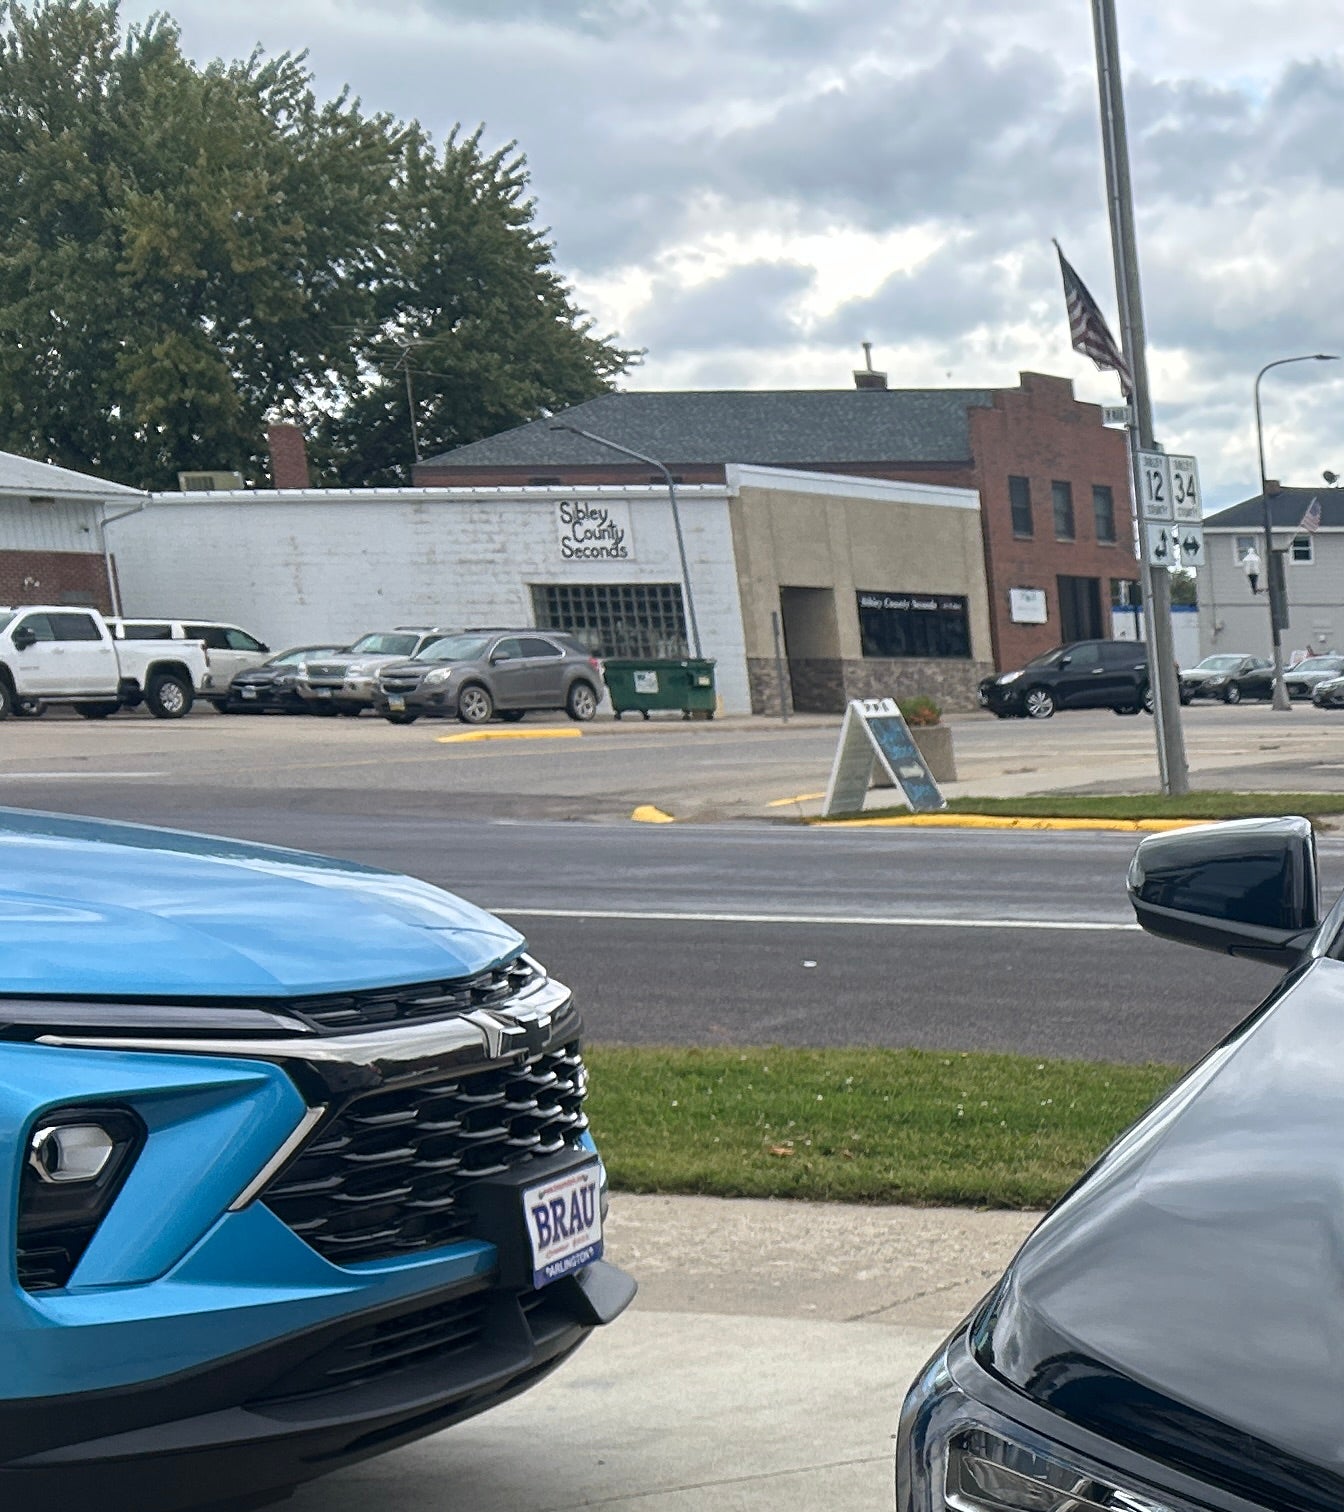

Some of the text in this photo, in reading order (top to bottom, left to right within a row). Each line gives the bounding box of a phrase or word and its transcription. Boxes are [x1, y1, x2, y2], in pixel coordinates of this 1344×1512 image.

[1146, 469, 1165, 502] 12
[1174, 472, 1196, 505] 34
[560, 501, 608, 527] Sibley
[572, 519, 624, 544] County
[561, 536, 628, 559] Seconds
[532, 1183, 595, 1251] BRAU
